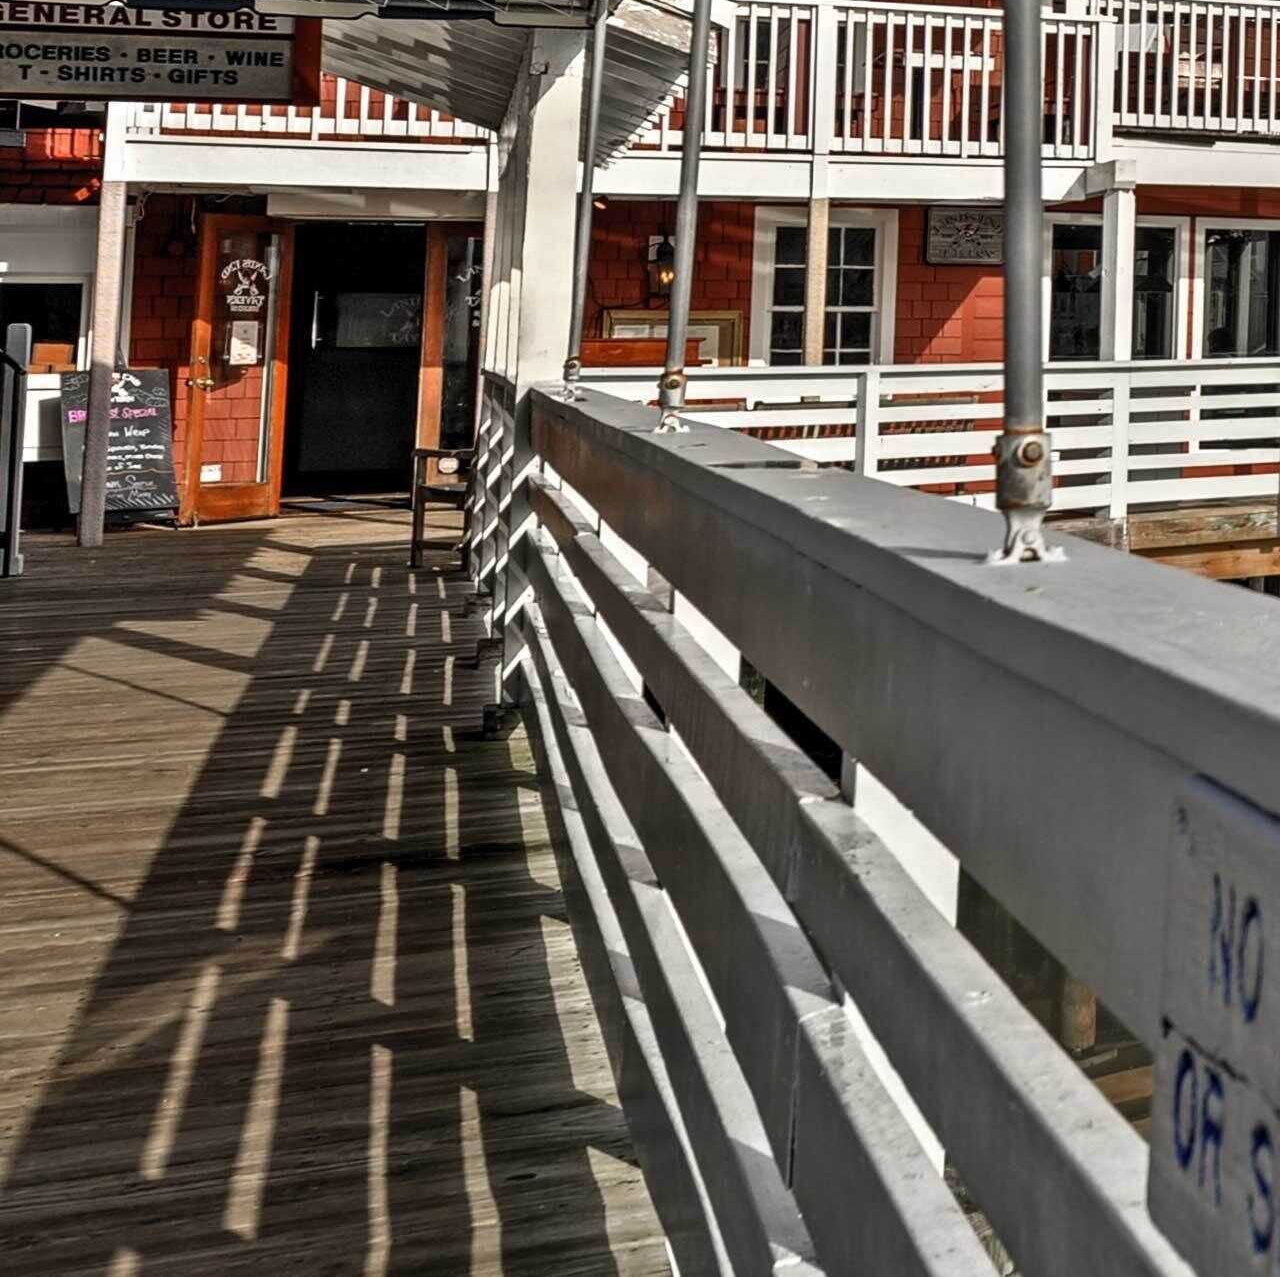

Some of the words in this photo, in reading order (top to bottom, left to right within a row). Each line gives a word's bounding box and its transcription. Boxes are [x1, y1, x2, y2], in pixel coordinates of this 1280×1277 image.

[0, 3, 151, 27] ENERAL
[161, 9, 278, 30] STORE
[136, 48, 198, 65] BEER
[225, 50, 284, 68] WINE
[168, 70, 238, 85] GIFTS
[1207, 874, 1265, 1024] NO
[1172, 1049, 1226, 1207] OR
